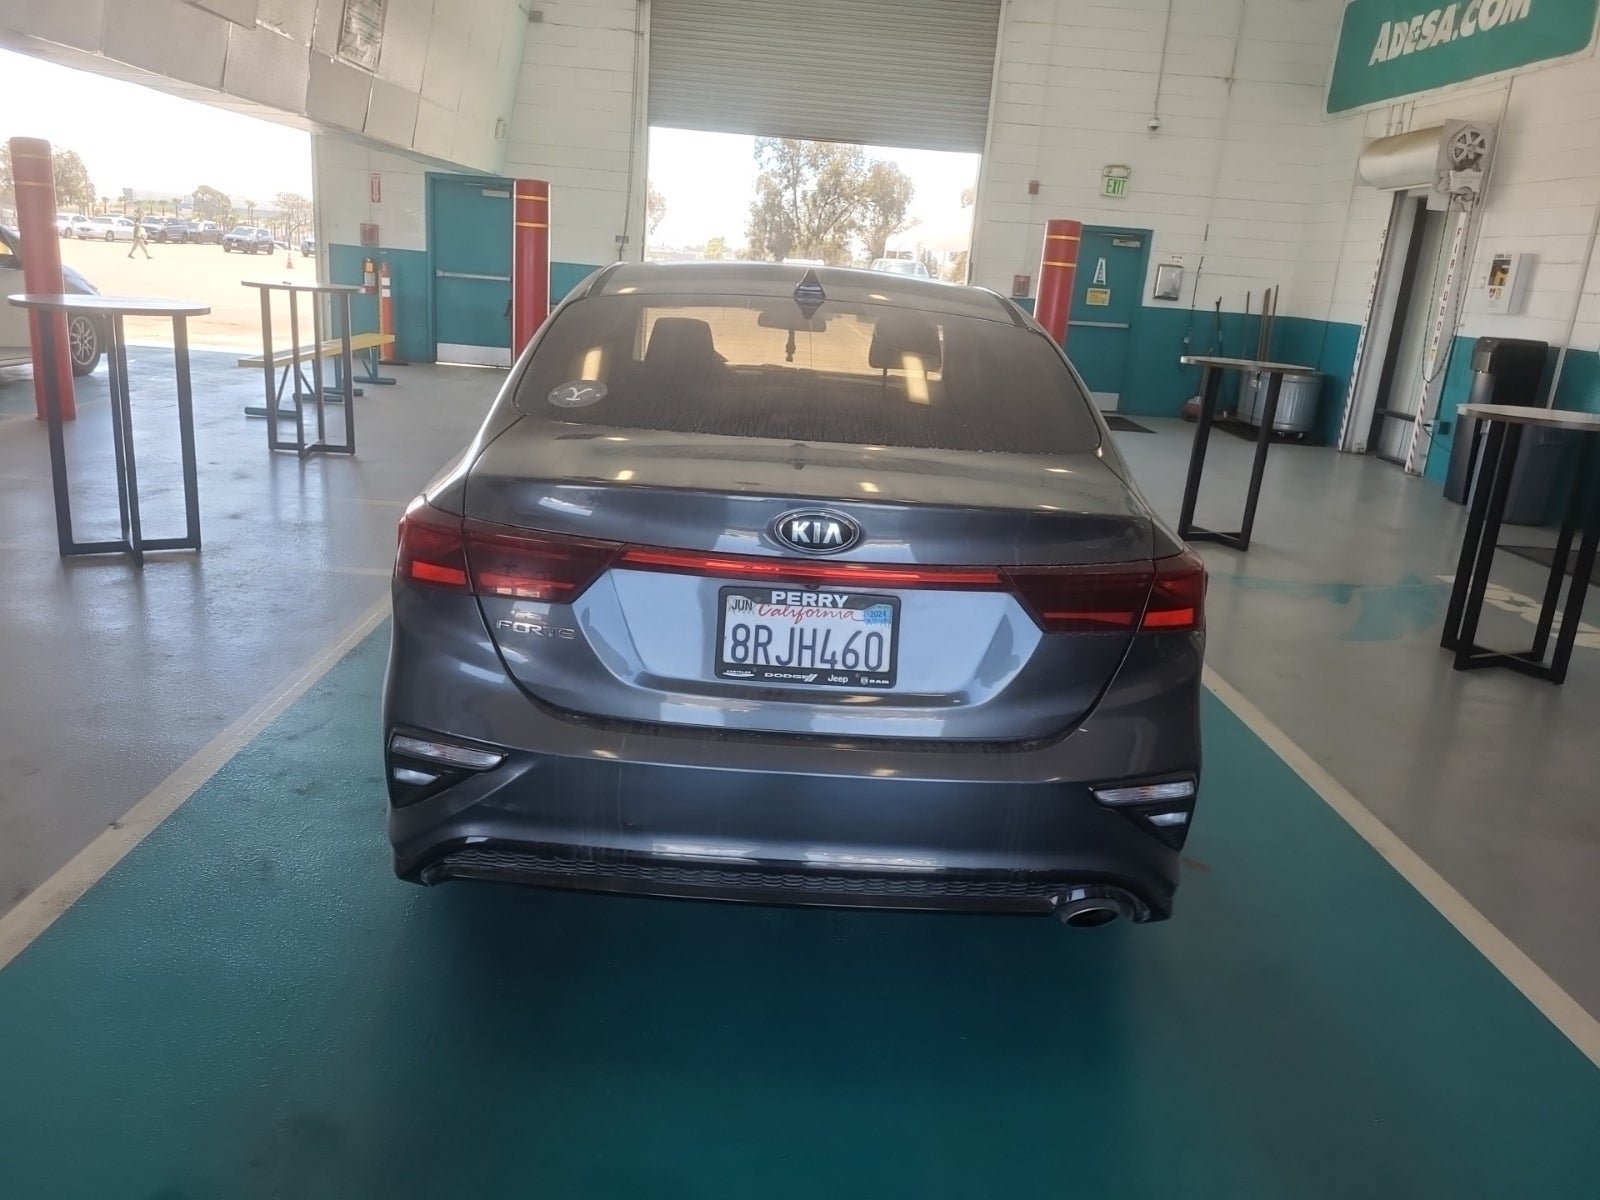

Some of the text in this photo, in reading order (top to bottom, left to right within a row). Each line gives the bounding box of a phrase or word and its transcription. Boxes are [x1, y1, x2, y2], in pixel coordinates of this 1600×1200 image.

[1367, 0, 1532, 67] ADESA.COM
[1105, 178, 1127, 196] EXIT
[791, 519, 843, 545] KIA
[731, 599, 753, 611] JUN
[771, 590, 849, 608] PERRY
[758, 604, 865, 624] California
[870, 610, 887, 618] 2024
[496, 619, 576, 640] FORTE
[730, 623, 884, 671] 8RJH460
[764, 672, 812, 681] DODGE
[827, 674, 849, 683] Jeep
